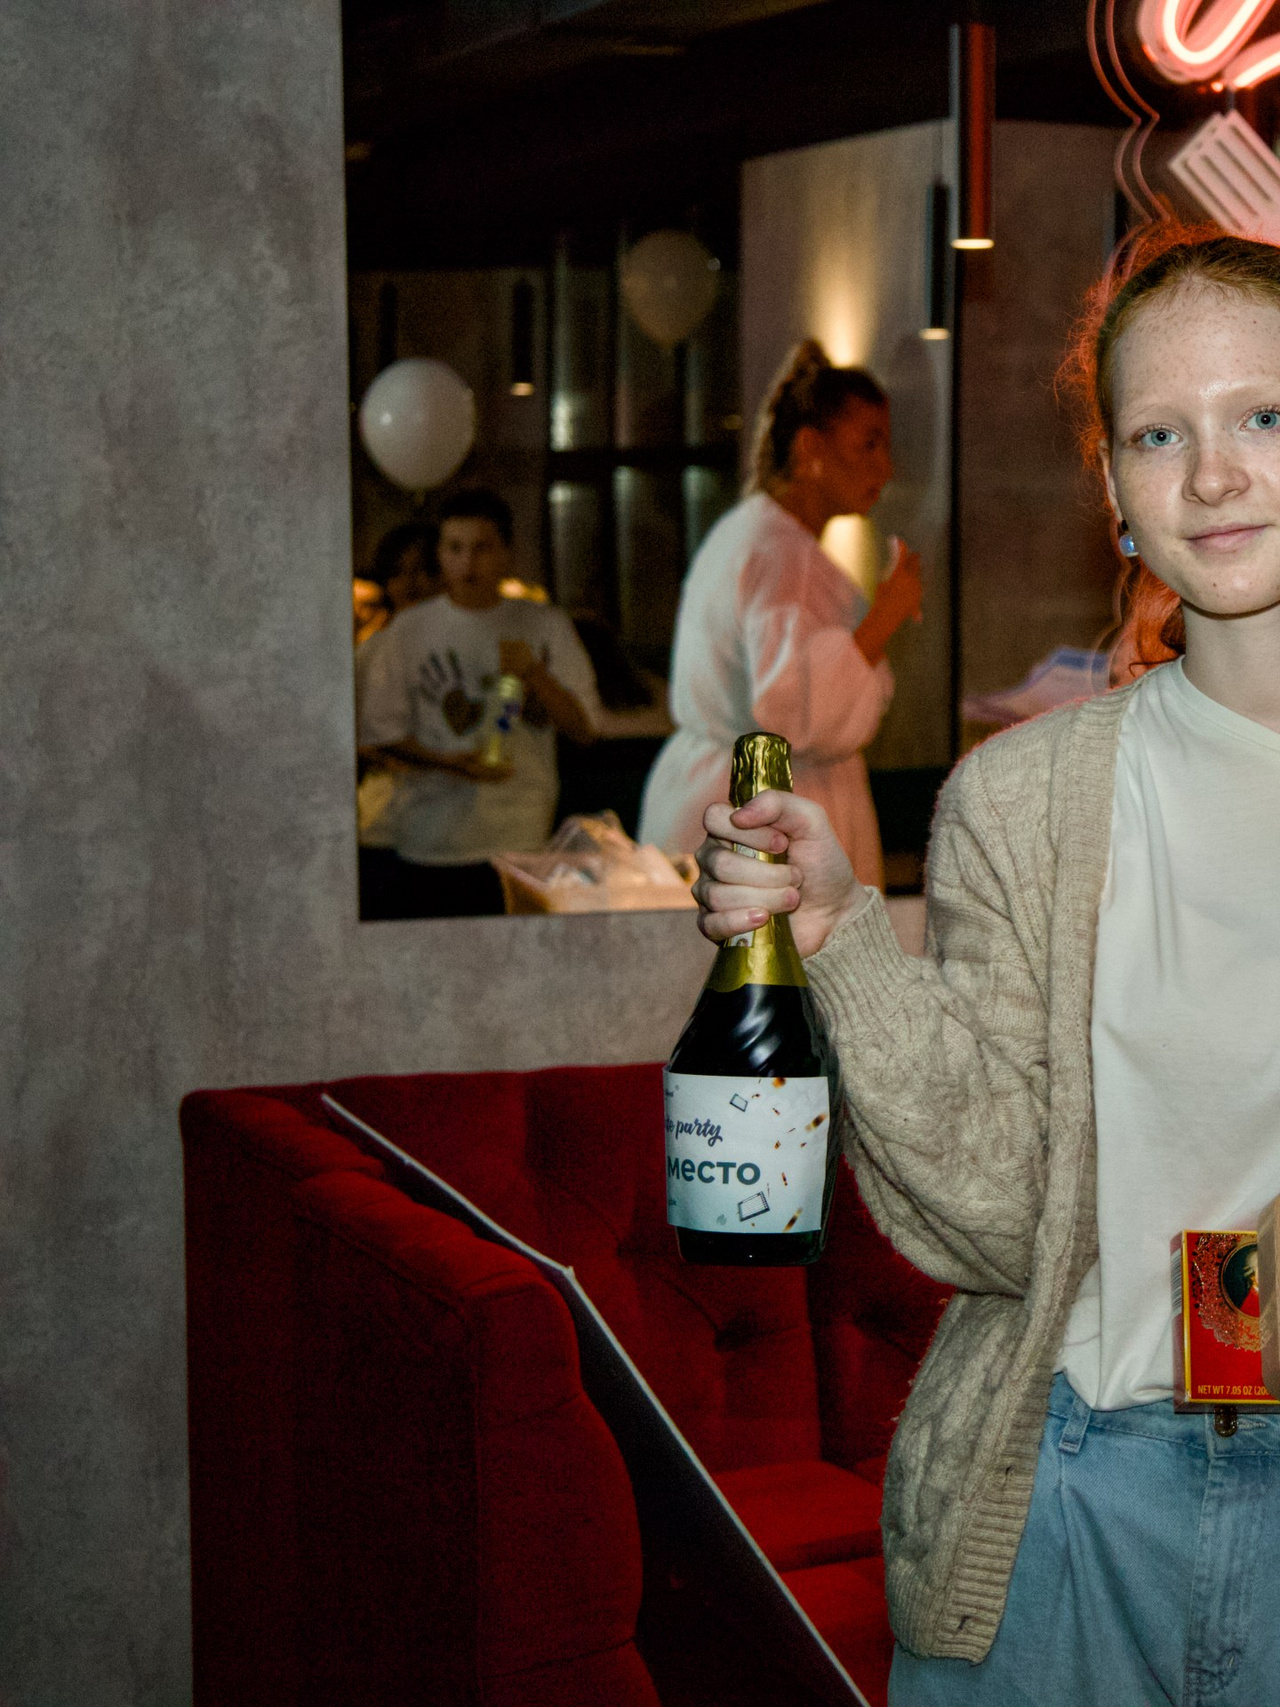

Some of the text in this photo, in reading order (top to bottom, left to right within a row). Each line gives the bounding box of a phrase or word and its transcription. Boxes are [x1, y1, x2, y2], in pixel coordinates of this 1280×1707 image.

[675, 1117, 723, 1147] party
[667, 1156, 760, 1186] место
[1198, 1385, 1211, 1395] NET
[1213, 1385, 1224, 1395] WT
[1226, 1386, 1241, 1396] 7.05
[1242, 1386, 1253, 1396] OZ
